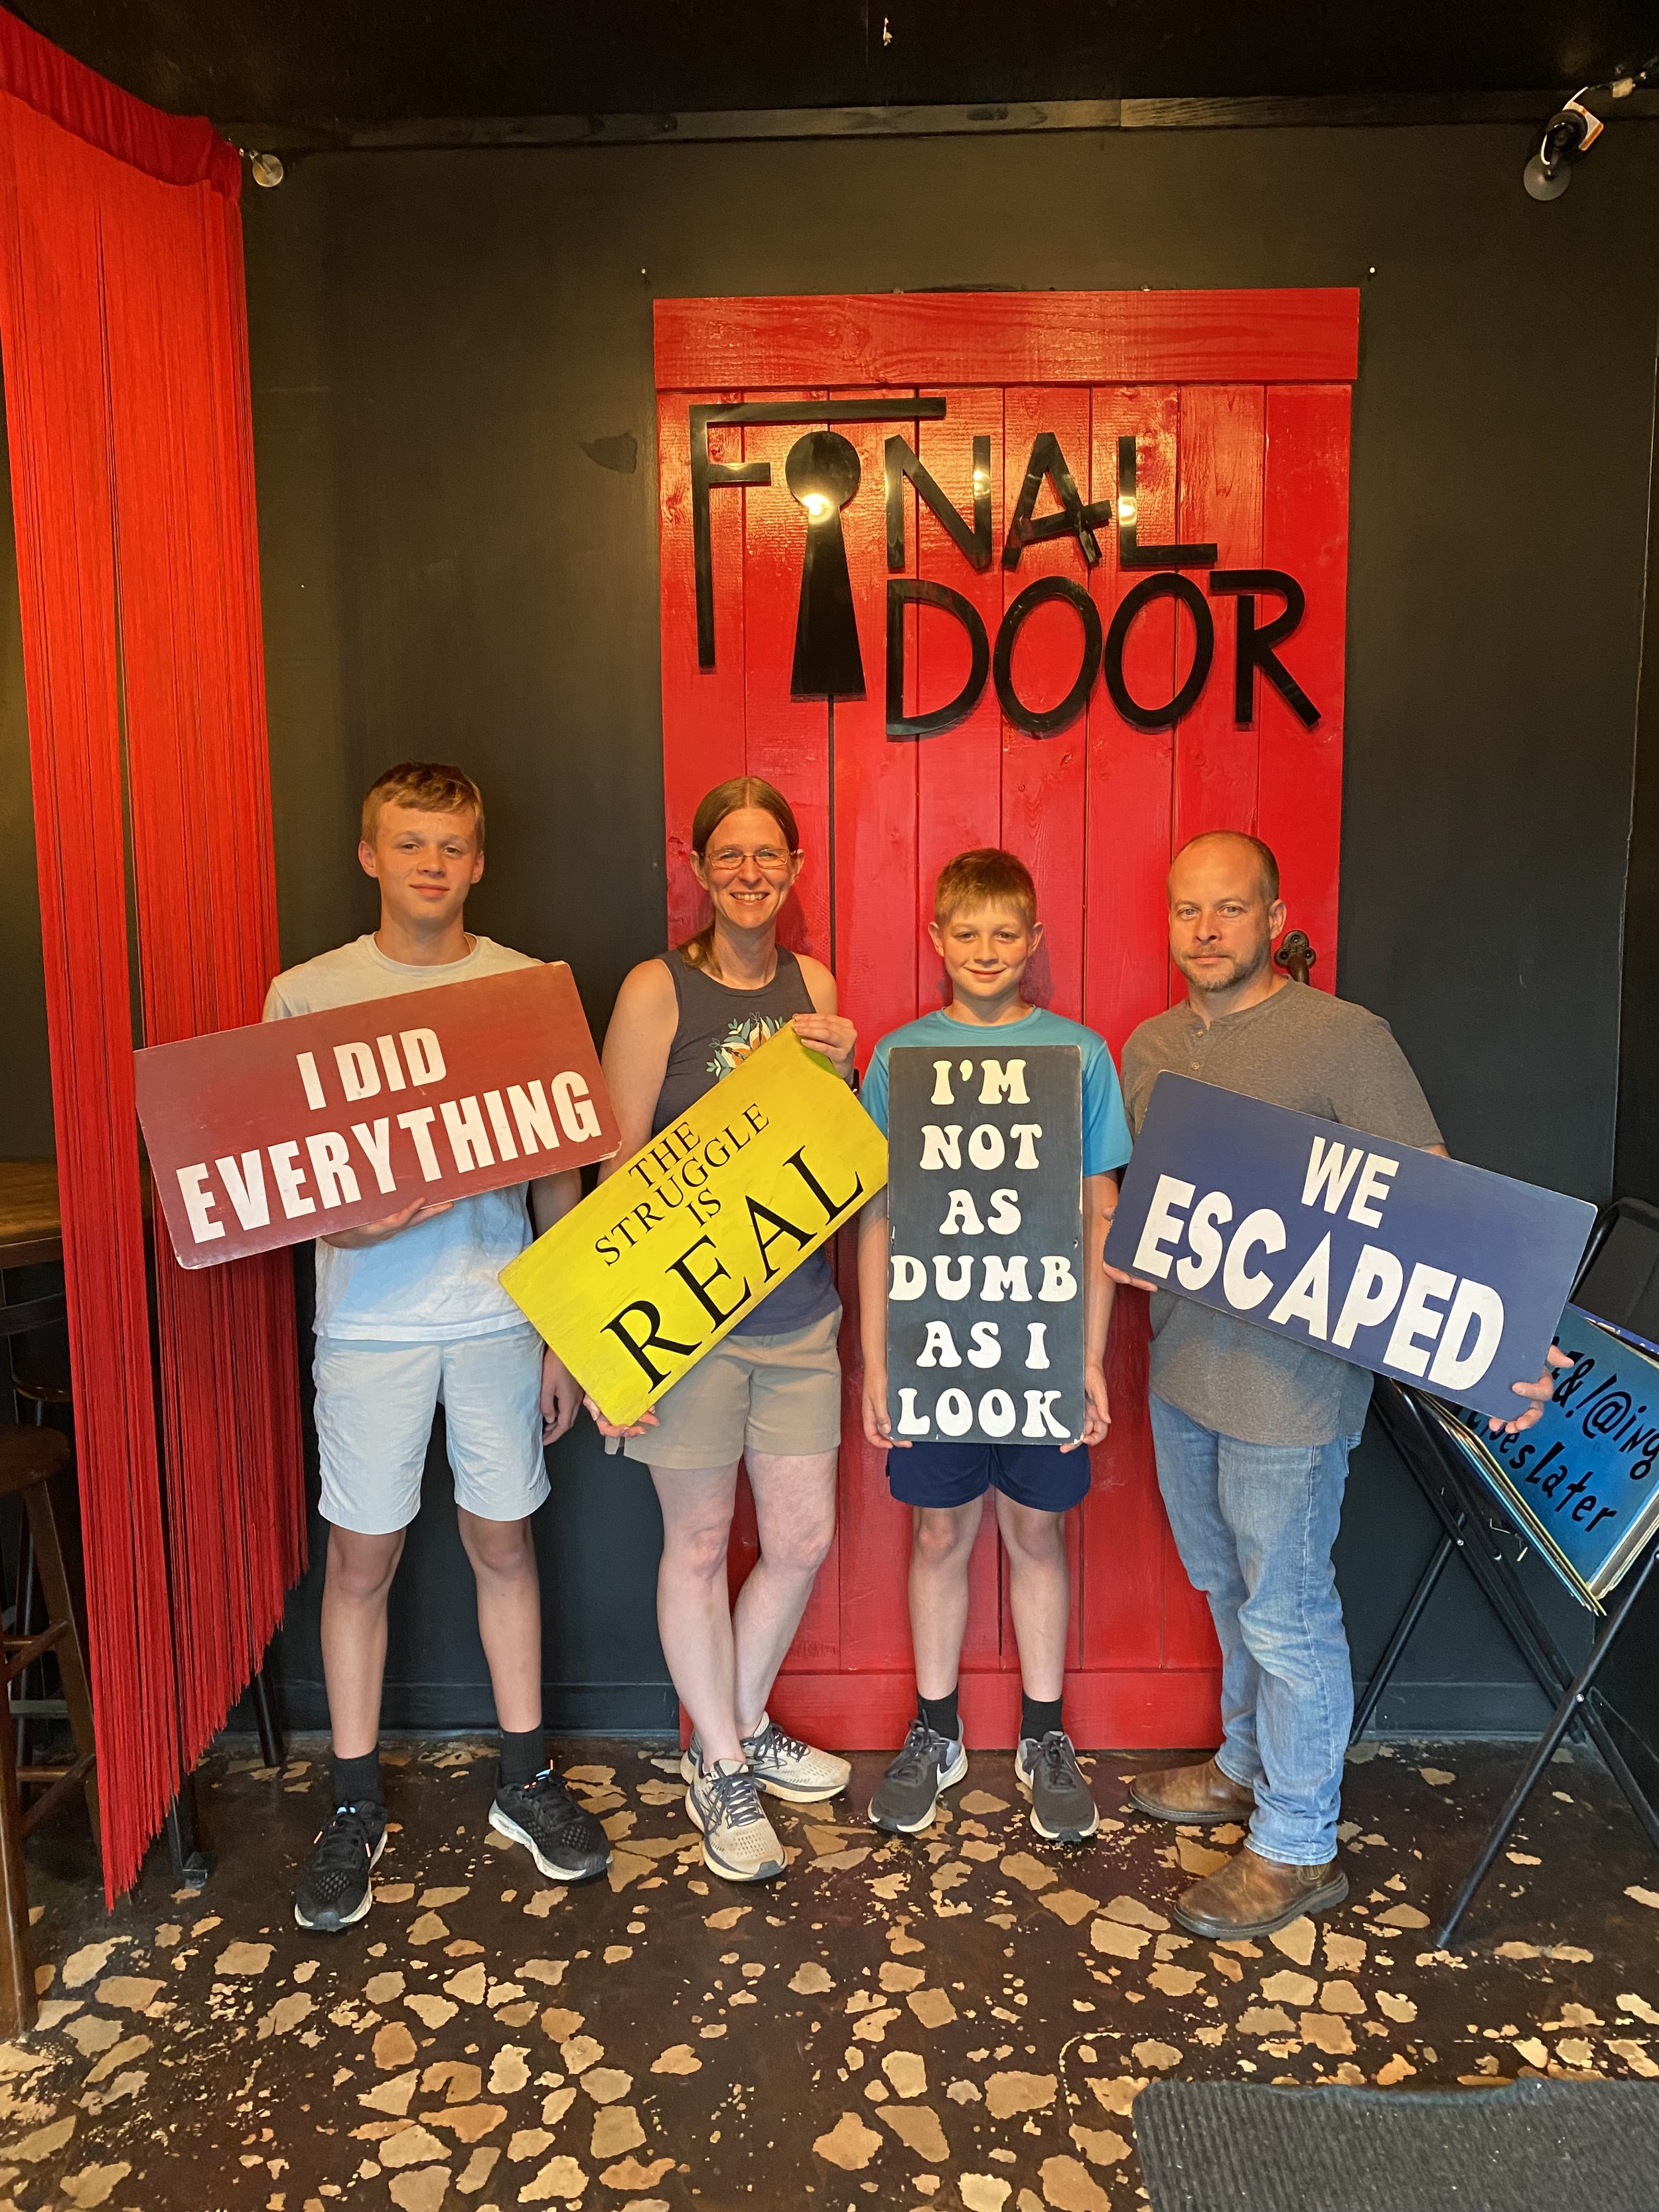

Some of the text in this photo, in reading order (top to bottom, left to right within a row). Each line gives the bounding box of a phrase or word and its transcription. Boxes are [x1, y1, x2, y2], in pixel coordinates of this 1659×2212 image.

[886, 569, 1321, 743] DOOR
[296, 1027, 447, 1110] I DID
[930, 1059, 1031, 1105] I'M
[176, 1070, 603, 1244] EVERYTHING
[595, 1103, 770, 1267] STRUGGLE
[628, 1120, 701, 1189] THE
[920, 1124, 1043, 1170] NOT
[1301, 1136, 1400, 1229] WE
[684, 1187, 721, 1229] IS
[939, 1189, 1022, 1235] AS
[600, 1145, 865, 1394] REAL
[889, 1255, 1078, 1302] DUMB
[1132, 1173, 1505, 1391] ESCAPED
[916, 1321, 1050, 1370] AS I
[897, 1387, 1072, 1439] LOOK
[1526, 1441, 1618, 1532] Later
